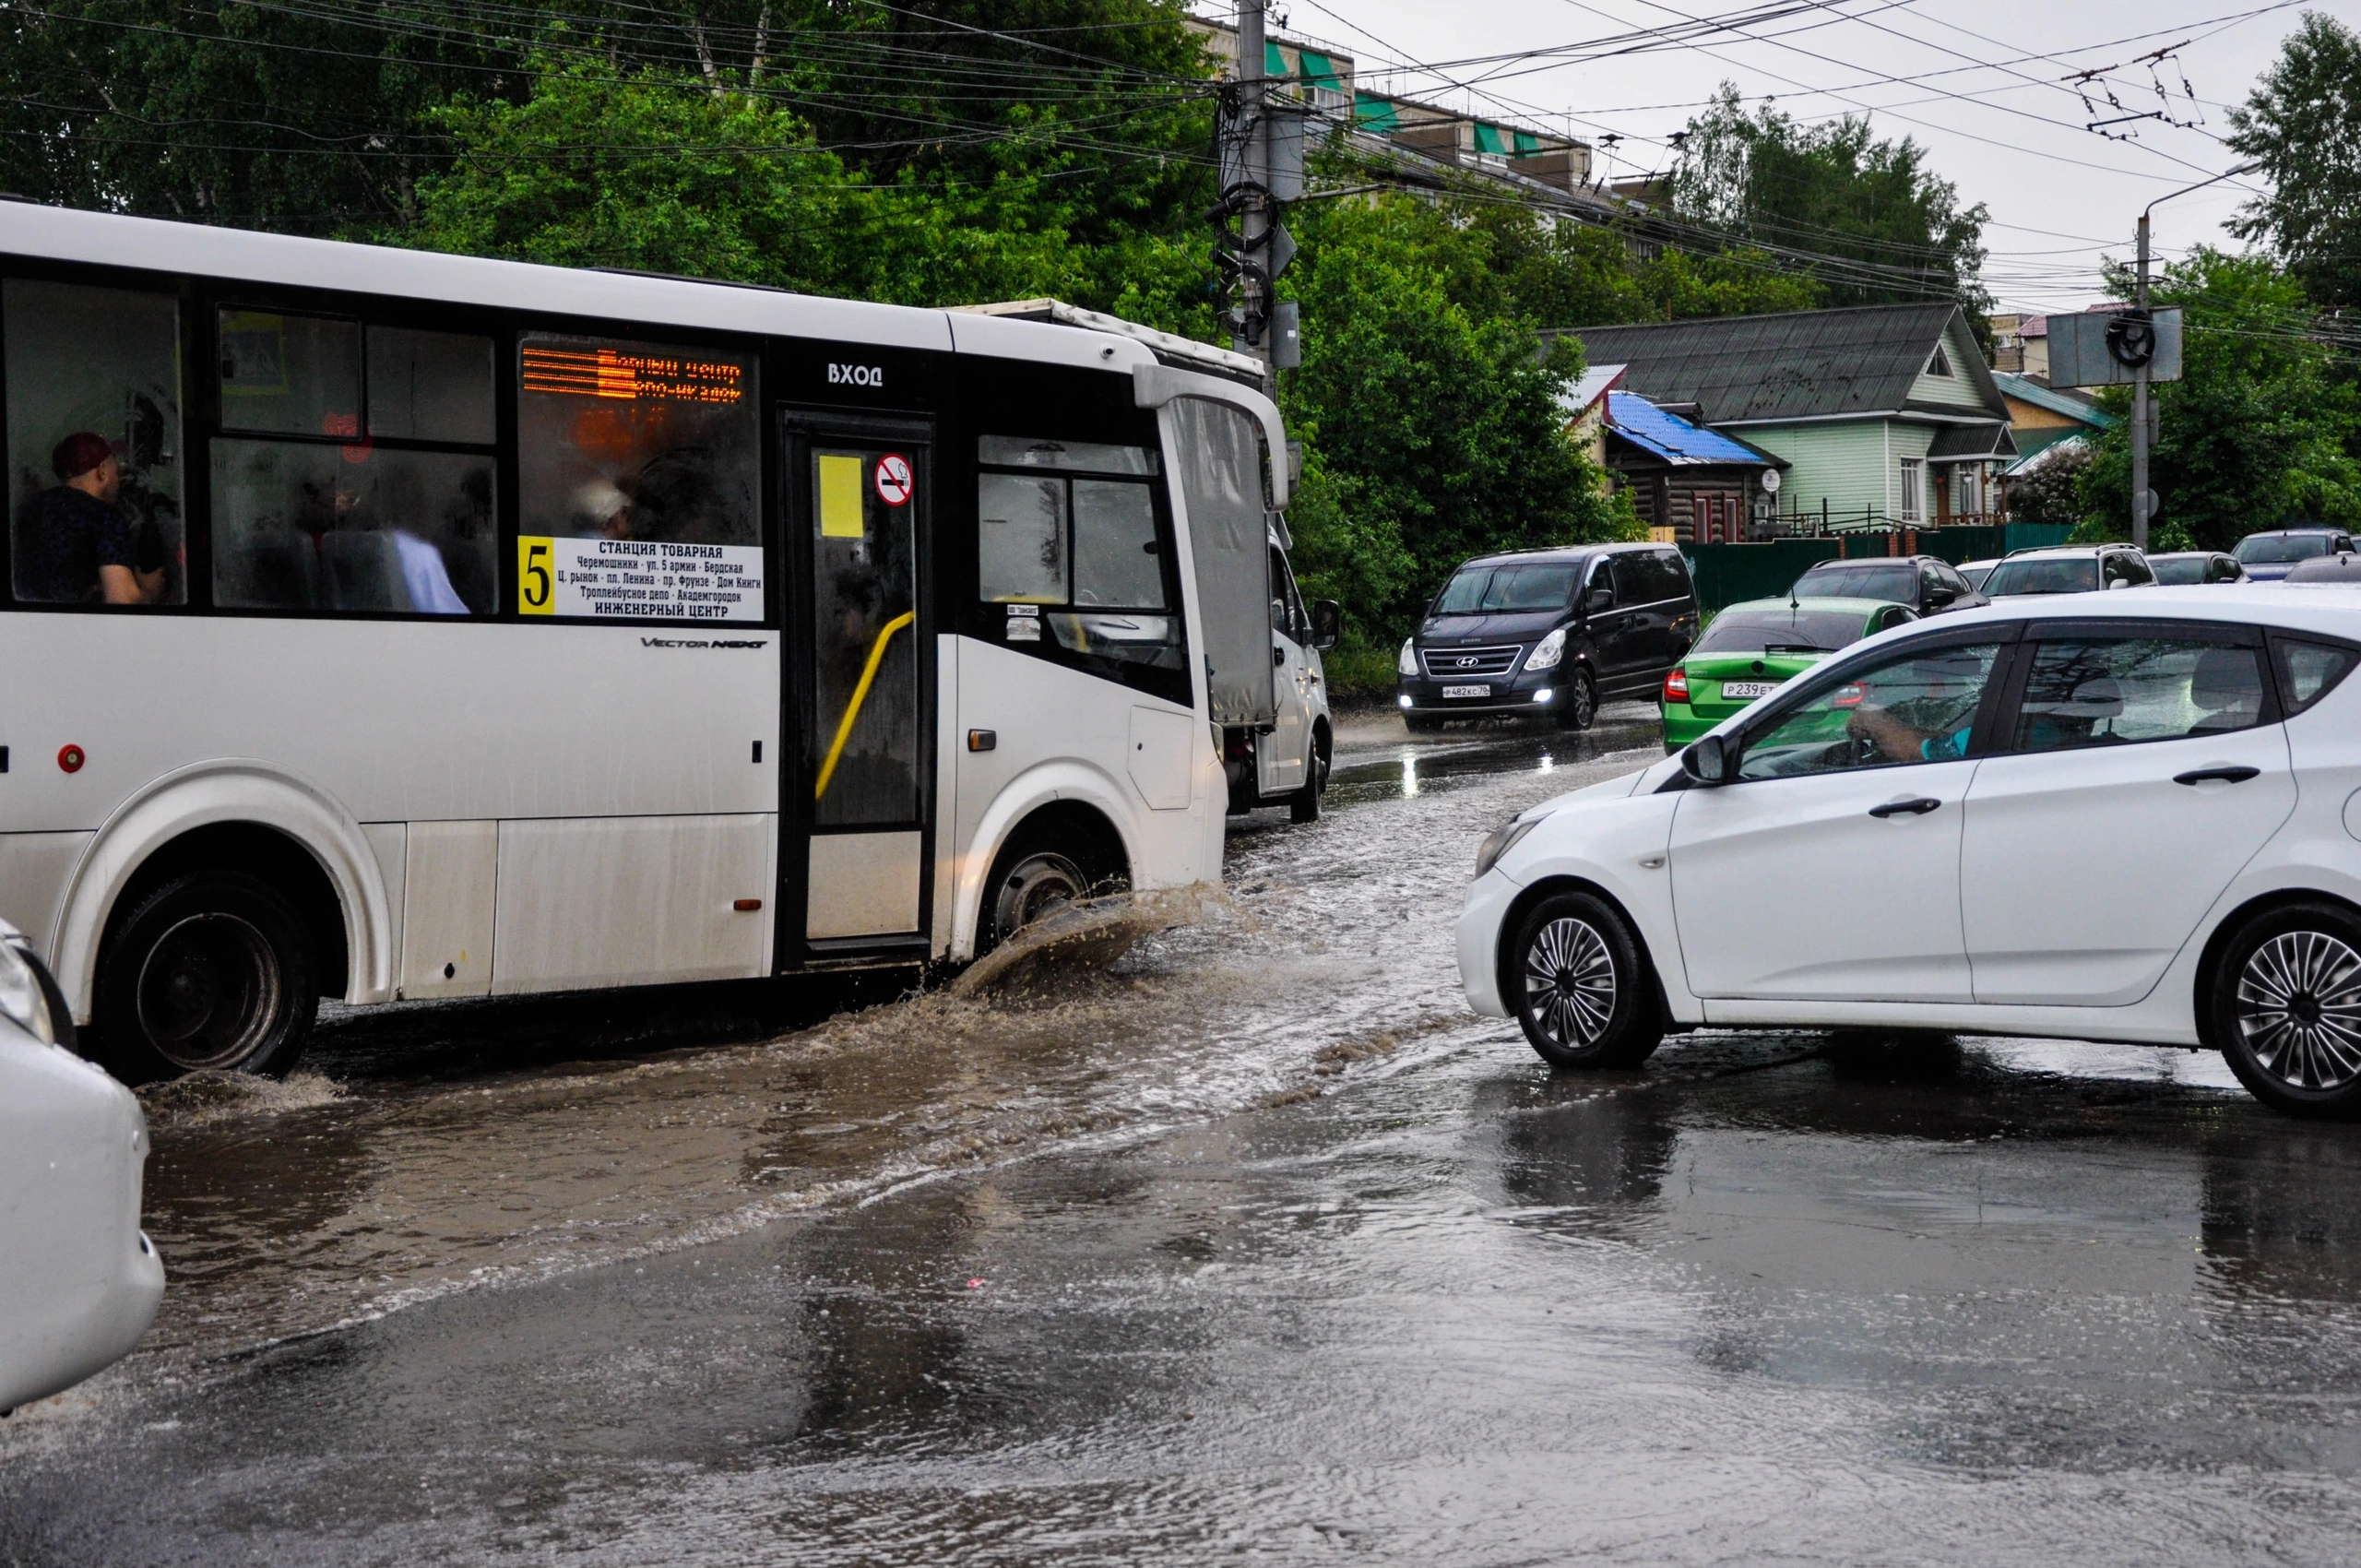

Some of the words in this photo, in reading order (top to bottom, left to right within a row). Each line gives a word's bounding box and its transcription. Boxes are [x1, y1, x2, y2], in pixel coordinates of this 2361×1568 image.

[828, 362, 883, 386] ВХОД
[599, 541, 657, 556] СТАНЦИЯ
[660, 544, 723, 559] ТОВАРНАЯ
[577, 555, 638, 570] Черемошники
[647, 560, 659, 573] ул.
[661, 559, 667, 571] 5
[670, 561, 696, 574] армии
[705, 561, 743, 576] Бердская
[524, 545, 551, 607] 5
[558, 570, 567, 584] Ц.
[570, 572, 599, 585] рынок
[607, 573, 621, 584] пл.
[623, 572, 655, 585] Ленина
[663, 576, 676, 588] пр.
[679, 576, 709, 588] Фрунзе
[718, 576, 733, 588] Дом
[736, 577, 761, 588] Книги
[580, 585, 647, 601] Троллейбусное
[648, 589, 670, 600] депо
[677, 589, 742, 604] Академгородок
[595, 601, 684, 616] ИНЖЕНЕРНЫЙ
[689, 605, 729, 618] ЦЕНТР
